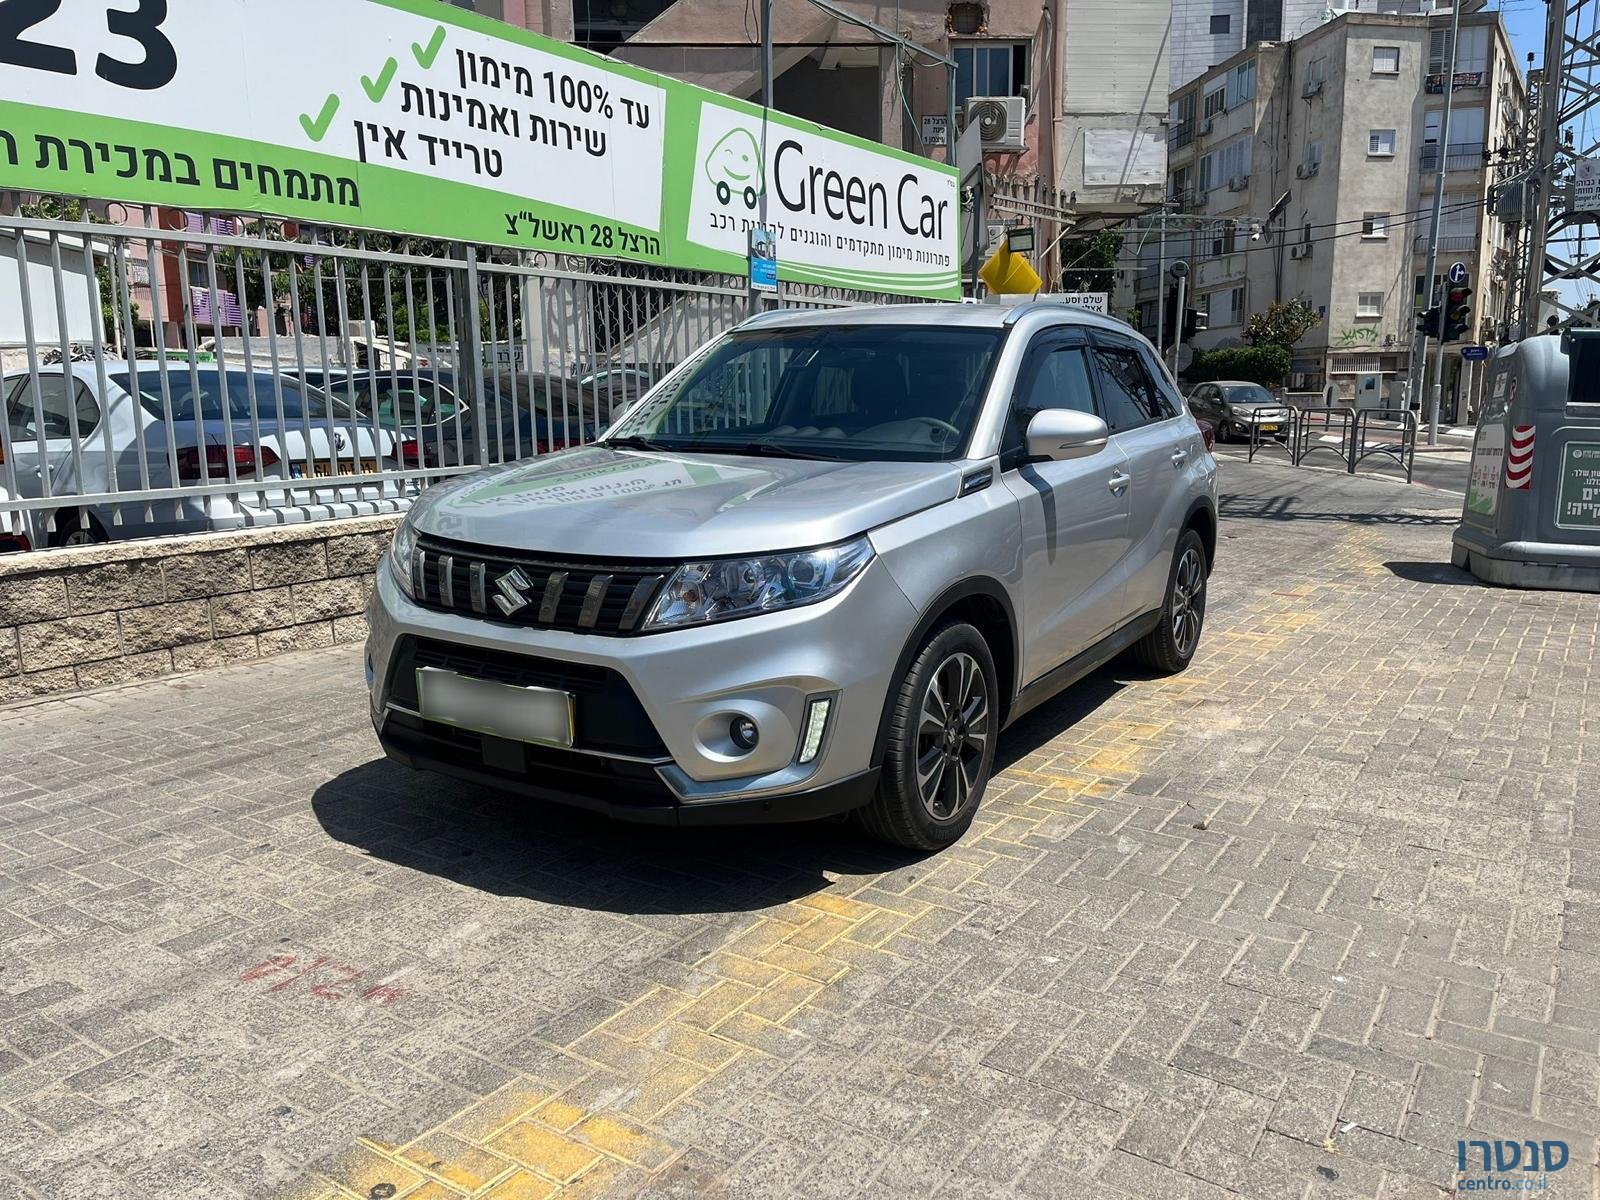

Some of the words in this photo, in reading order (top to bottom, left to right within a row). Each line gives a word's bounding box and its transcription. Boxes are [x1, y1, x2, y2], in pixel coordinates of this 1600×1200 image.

[455, 48, 534, 98] מימון
[400, 81, 520, 138] ואמינות
[543, 71, 613, 119] 100%
[619, 97, 650, 129] עד
[353, 120, 409, 163] אין
[530, 113, 607, 157] שירות
[34, 134, 201, 186] במכירת
[418, 133, 503, 178] טרייד
[213, 158, 361, 208] מתמחים
[773, 139, 889, 230] Green
[897, 174, 949, 241] Car
[590, 224, 614, 249] 28
[618, 226, 660, 255] הרצל
[710, 212, 736, 232] רכב
[790, 228, 832, 248] והוגנים
[836, 236, 885, 257] מתקדמים
[888, 244, 913, 261] מימון
[915, 250, 951, 267] פתרונות
[1083, 295, 1103, 304] שלם
